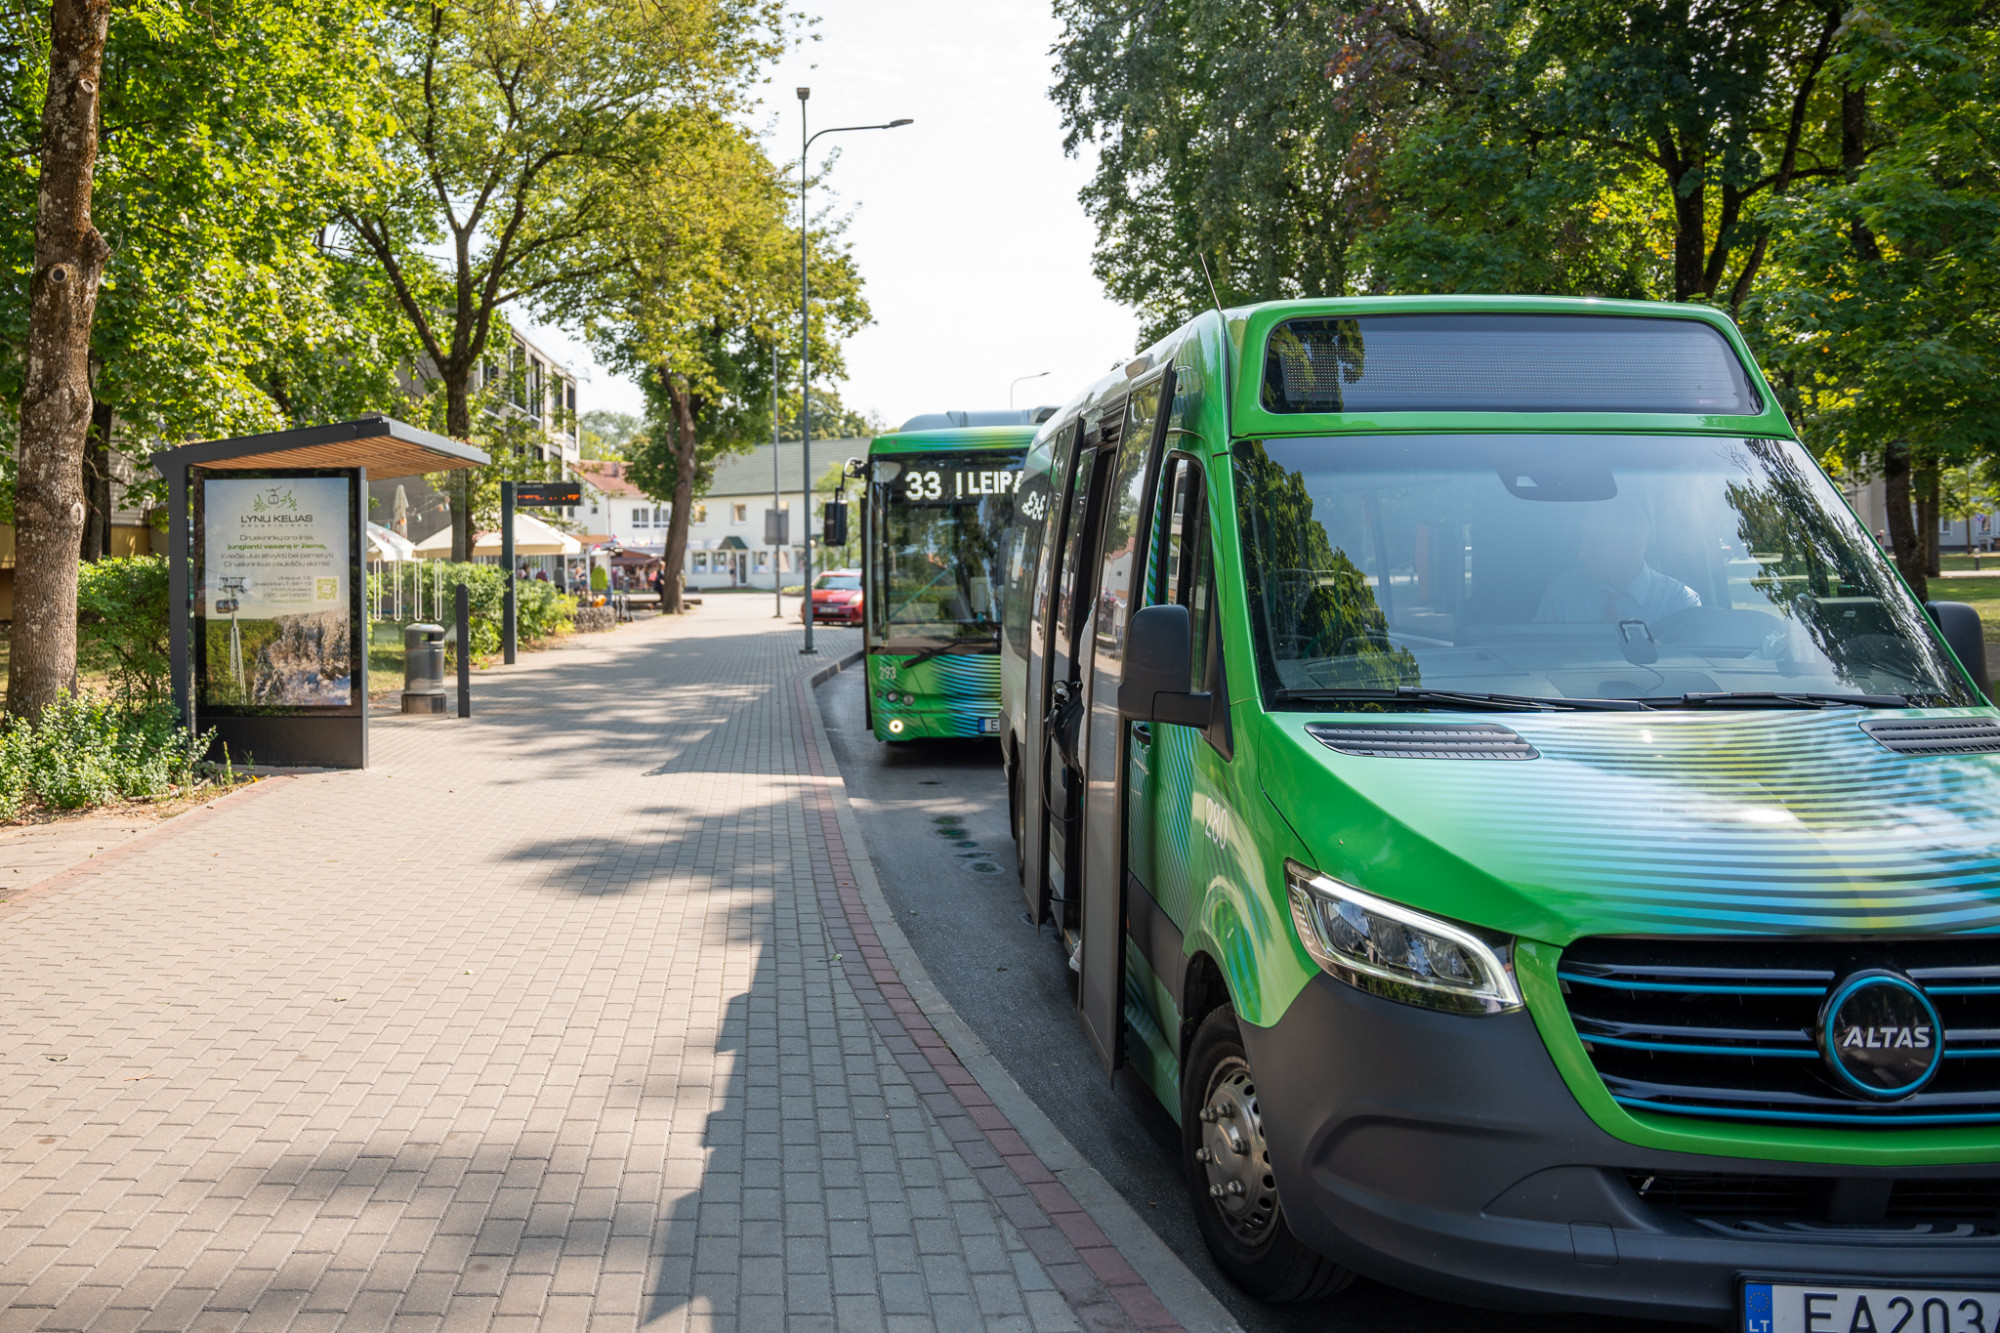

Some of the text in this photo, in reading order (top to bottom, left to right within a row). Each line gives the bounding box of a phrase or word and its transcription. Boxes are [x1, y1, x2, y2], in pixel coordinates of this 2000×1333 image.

[905, 471, 942, 500] 33
[273, 514, 313, 523] KELIAS
[1205, 797, 1228, 850] 280
[1843, 1026, 1930, 1048] ALTAS
[1748, 1292, 2000, 1333] LT EA203
